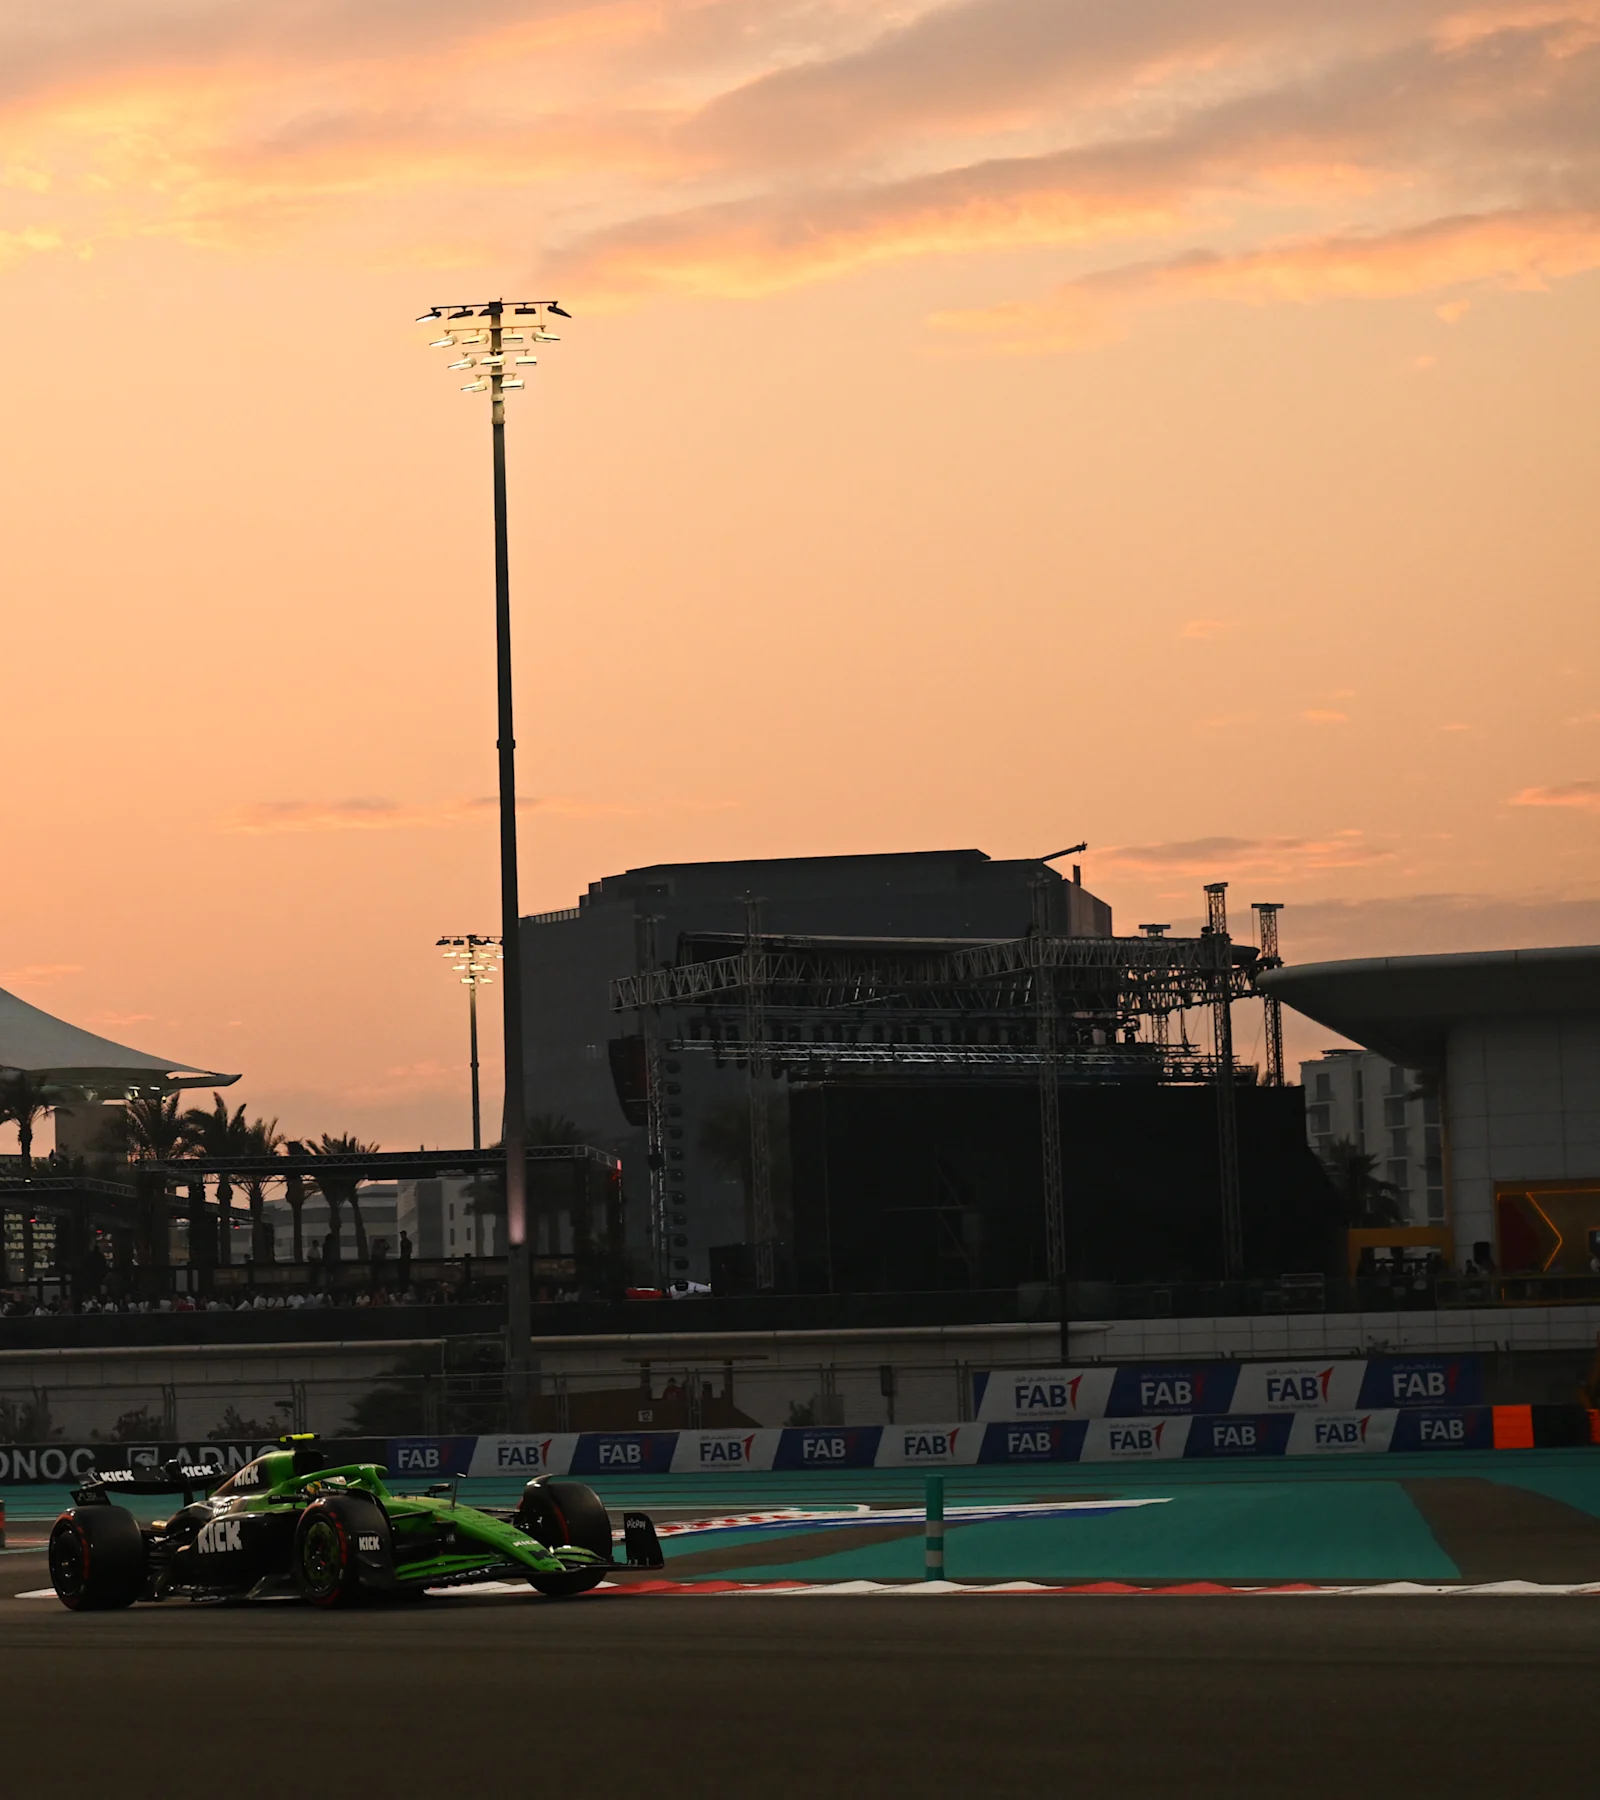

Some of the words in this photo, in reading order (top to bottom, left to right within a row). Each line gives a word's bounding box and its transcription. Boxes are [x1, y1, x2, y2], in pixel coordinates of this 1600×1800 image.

[1141, 1381, 1192, 1405] FAB
[1267, 1377, 1318, 1401] FAB
[1392, 1373, 1445, 1397] FAB
[1015, 1385, 1067, 1408] FAB
[641, 1411, 650, 1420] 12
[1110, 1429, 1153, 1450] FAB
[1213, 1426, 1256, 1447] FAB
[1316, 1423, 1358, 1443] FAB
[1420, 1419, 1464, 1440] FAB
[700, 1441, 742, 1462] FAB
[803, 1438, 846, 1458] FAB
[904, 1435, 947, 1455] FAB
[1008, 1432, 1051, 1453] FAB
[397, 1449, 439, 1469] FAB
[498, 1446, 539, 1467] FAB
[600, 1443, 641, 1464] FAB
[100, 1470, 134, 1482] KICK
[181, 1465, 214, 1478] KICK
[234, 1465, 259, 1487] KICK
[198, 1521, 243, 1554] KICK
[359, 1536, 380, 1550] KICK
